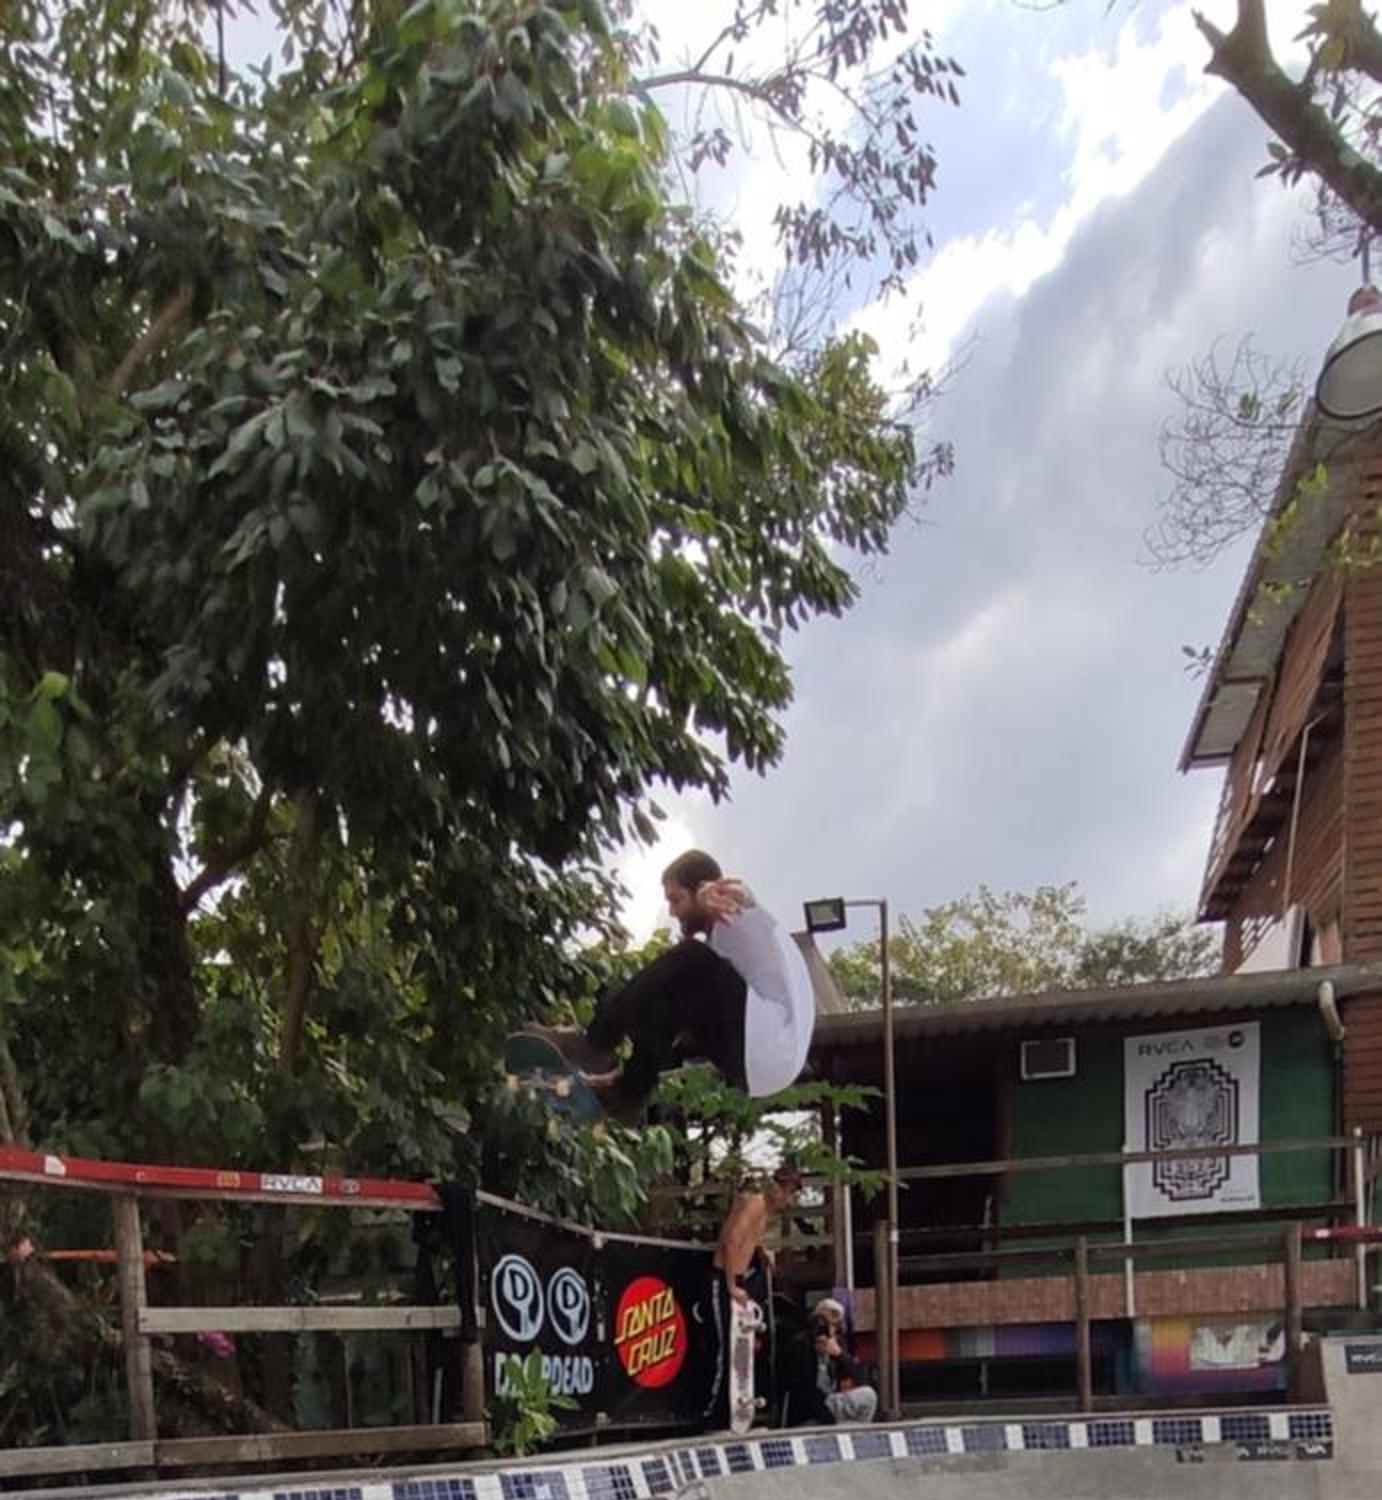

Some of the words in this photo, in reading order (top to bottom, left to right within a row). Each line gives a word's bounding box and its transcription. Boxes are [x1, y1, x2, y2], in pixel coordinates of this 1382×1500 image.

[1137, 1039, 1194, 1056] RVCA
[262, 1175, 321, 1192] RVCA
[614, 1287, 675, 1344] SANTA
[627, 1325, 677, 1376] CRUZ
